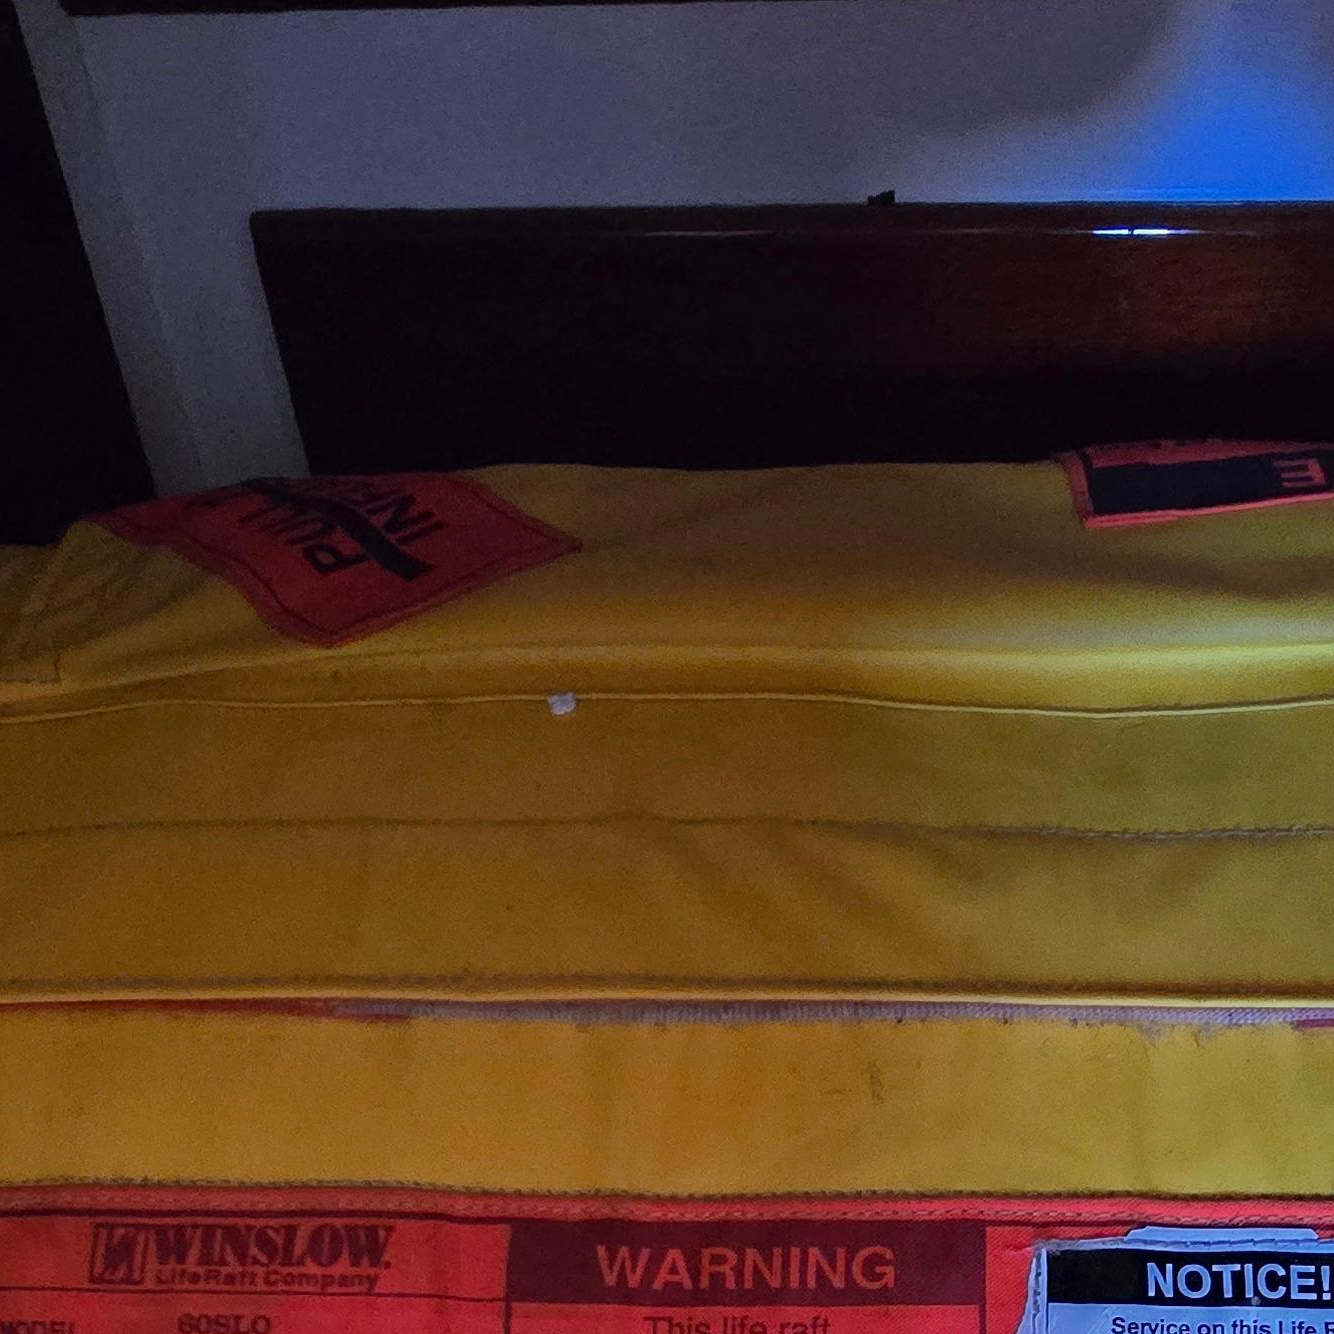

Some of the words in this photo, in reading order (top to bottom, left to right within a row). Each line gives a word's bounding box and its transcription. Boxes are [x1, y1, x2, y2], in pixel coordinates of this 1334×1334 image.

[264, 1270, 378, 1291] Company
[596, 1243, 898, 1291] WARNING
[1147, 1262, 1331, 1301] NOTICE!
